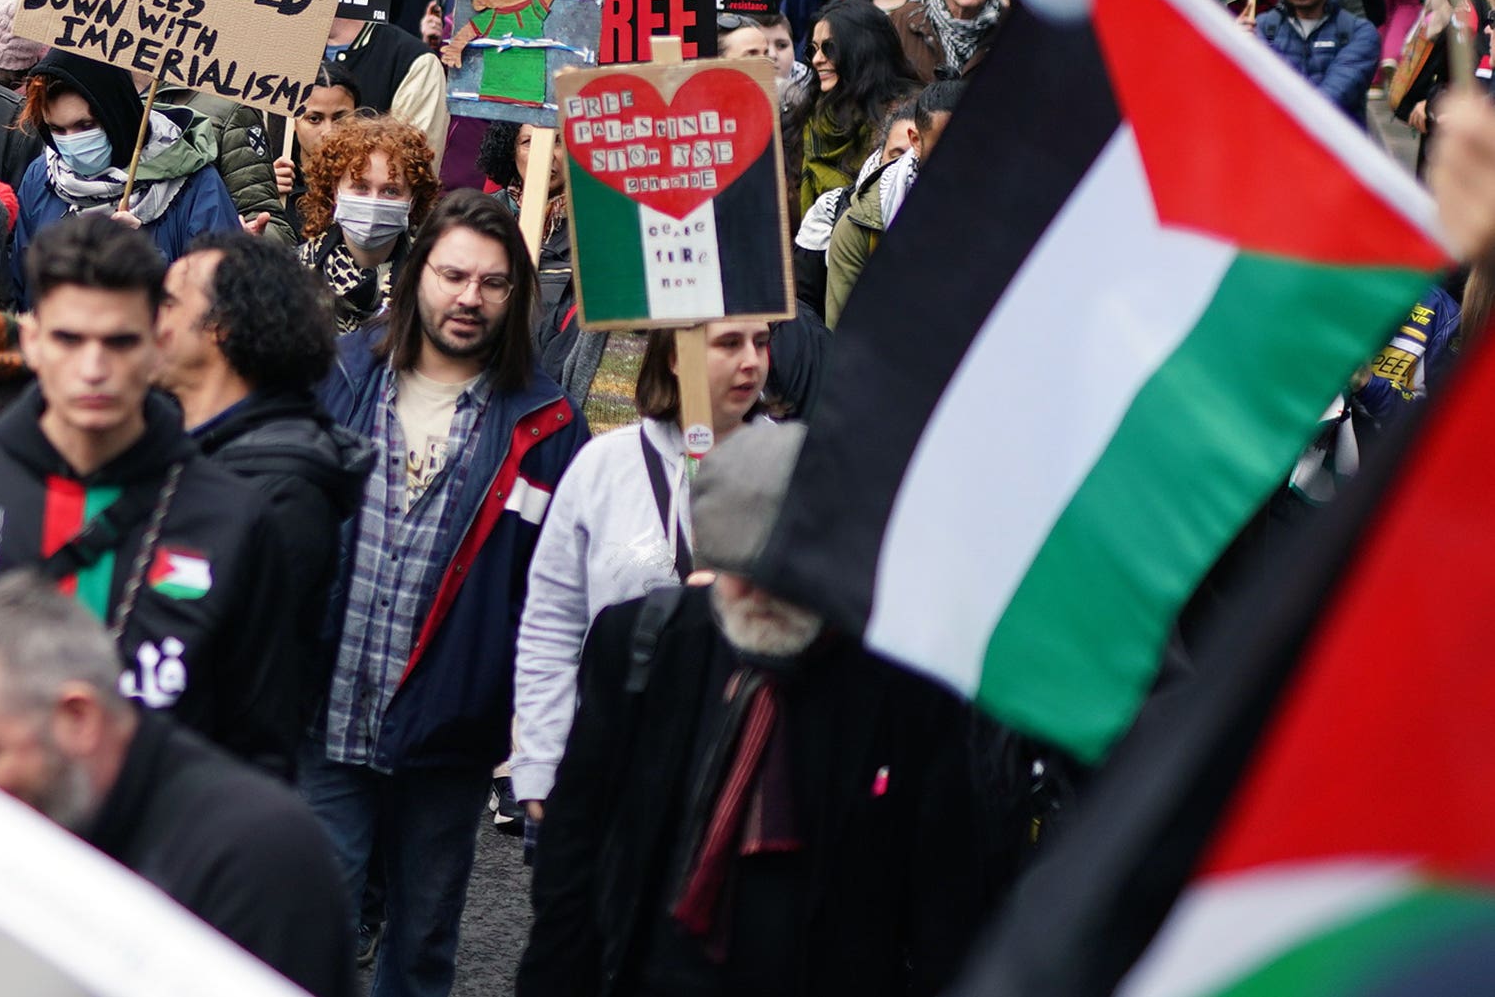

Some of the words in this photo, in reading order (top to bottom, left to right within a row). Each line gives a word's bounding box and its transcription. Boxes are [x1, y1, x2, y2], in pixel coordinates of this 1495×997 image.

[139, 5, 218, 56] WITH
[53, 15, 316, 118] IMPERIALISM!
[567, 90, 635, 119] FREE
